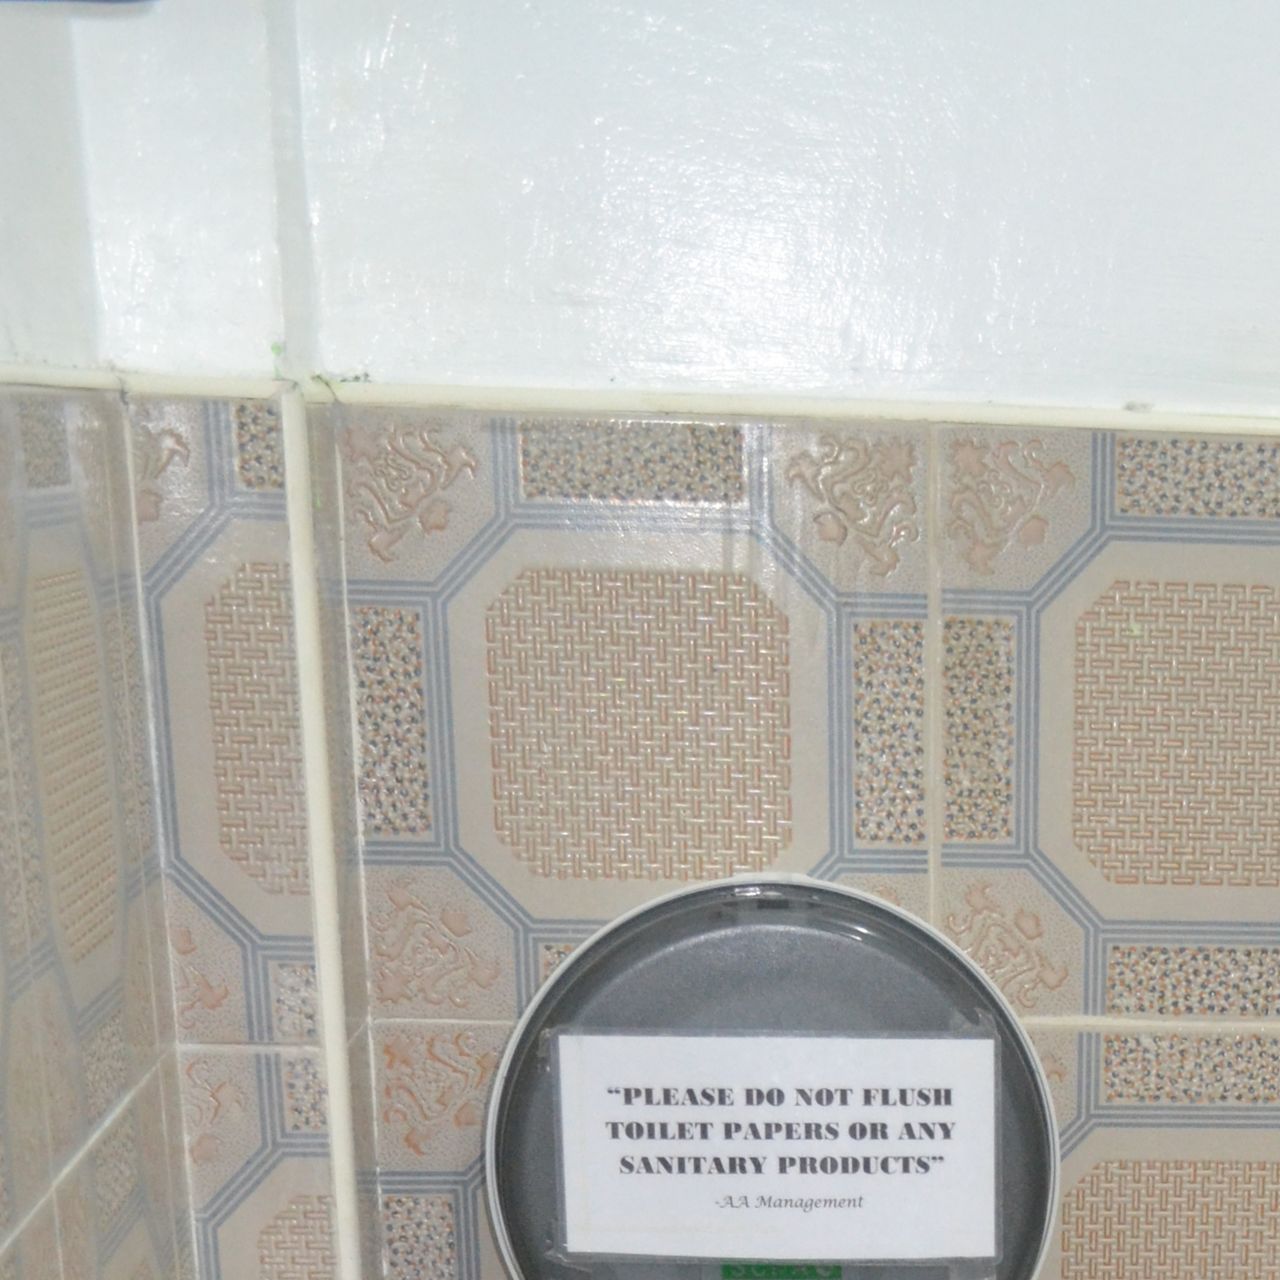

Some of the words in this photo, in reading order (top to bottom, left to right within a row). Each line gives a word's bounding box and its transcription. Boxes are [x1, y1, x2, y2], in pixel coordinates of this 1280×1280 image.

[745, 1087, 786, 1107] DO
[795, 1087, 854, 1107] NOT
[862, 1087, 954, 1107] FLUSH
[605, 1121, 714, 1141] TOILET
[723, 1121, 840, 1141] PAPERS
[848, 1121, 889, 1141] OR
[898, 1121, 957, 1141] ANY
[619, 1155, 768, 1175] SANITARY
[714, 1194, 751, 1209] -AA
[754, 1194, 864, 1213] Management
